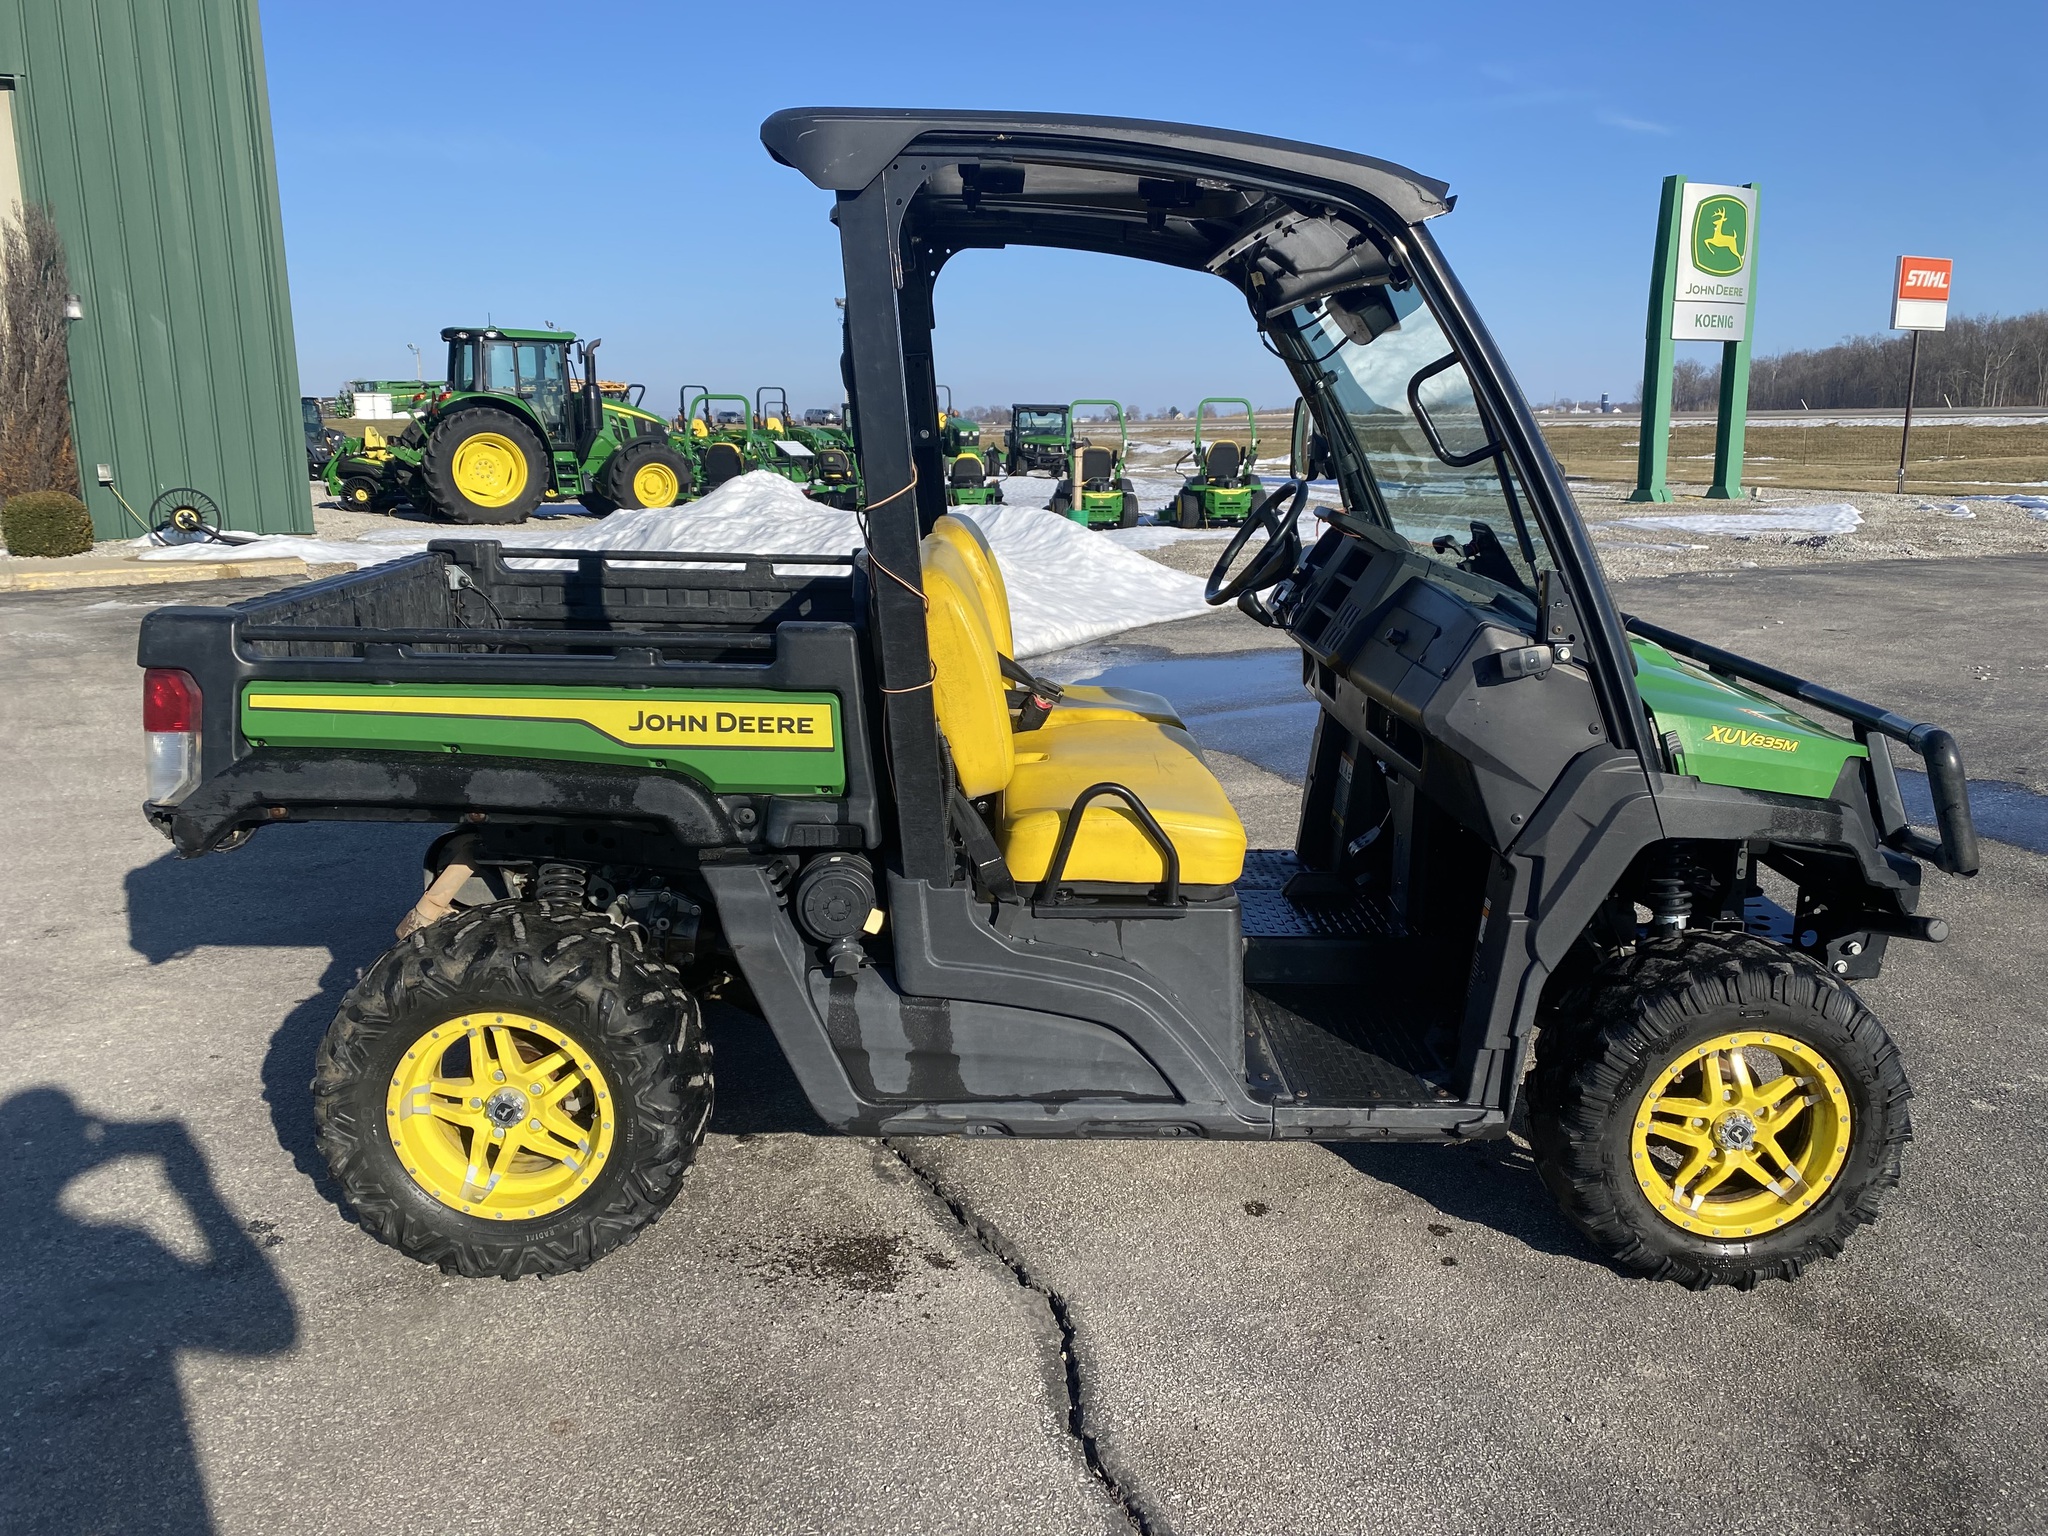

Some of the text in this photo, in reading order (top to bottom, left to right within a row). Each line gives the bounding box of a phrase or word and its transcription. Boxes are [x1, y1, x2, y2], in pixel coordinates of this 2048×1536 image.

[1905, 269, 1949, 288] STIHL
[1685, 283, 1744, 297] JOHN DEERE
[1695, 313, 1734, 329] KOENIG
[628, 710, 814, 734] JOHN DEERE
[1703, 725, 1800, 752] XUV835M
[525, 1227, 555, 1242] RADIAL
